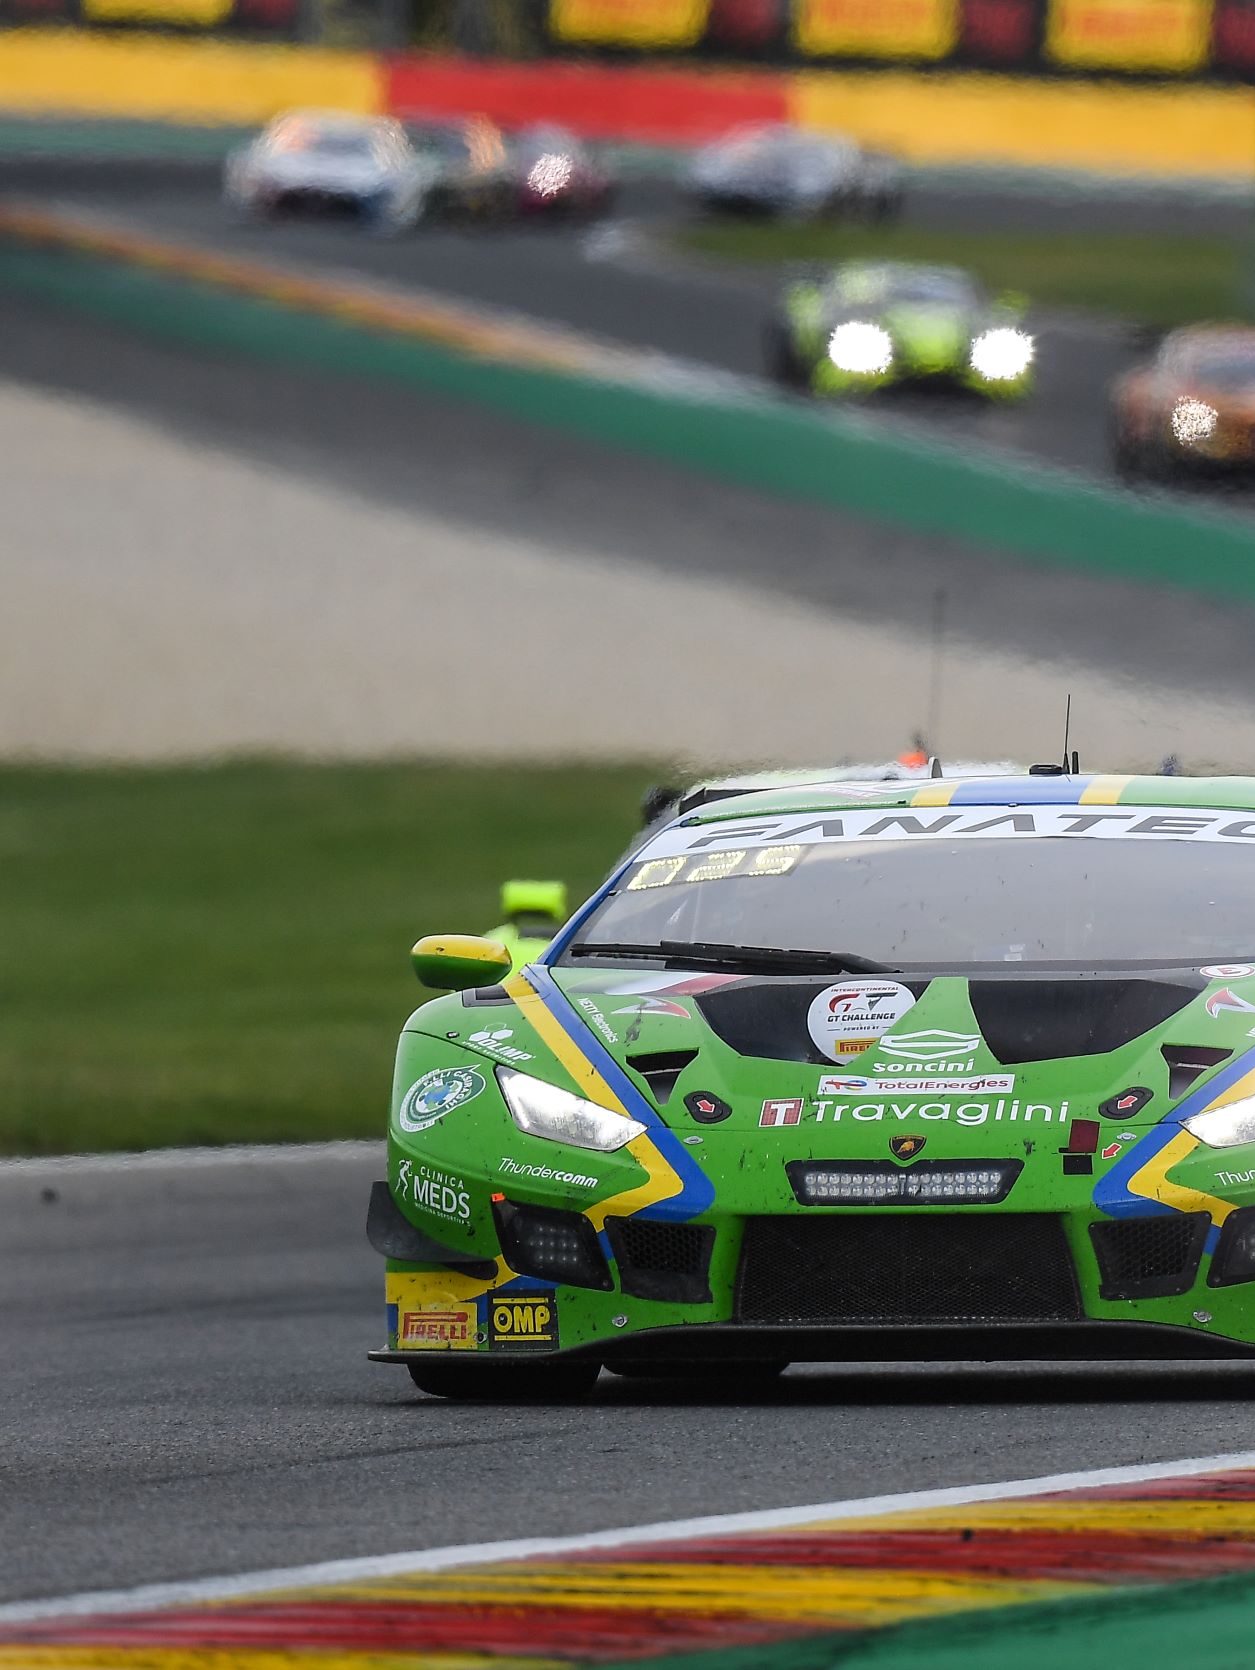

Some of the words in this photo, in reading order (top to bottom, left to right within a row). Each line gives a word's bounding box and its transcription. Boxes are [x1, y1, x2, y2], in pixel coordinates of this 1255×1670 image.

[827, 1014, 841, 1023] GT
[841, 1012, 896, 1022] CHALLENGE
[477, 1038, 533, 1061] OLIMP
[871, 1057, 975, 1073] soncini
[875, 1077, 1009, 1091] TotalEnergies
[812, 1099, 1070, 1126] Travaglini
[420, 1166, 464, 1190] CLINICA
[499, 1157, 599, 1188] Thundercomm
[413, 1175, 470, 1219] MEDS
[402, 1311, 469, 1340] PIRELLI
[493, 1304, 551, 1334] OMP
